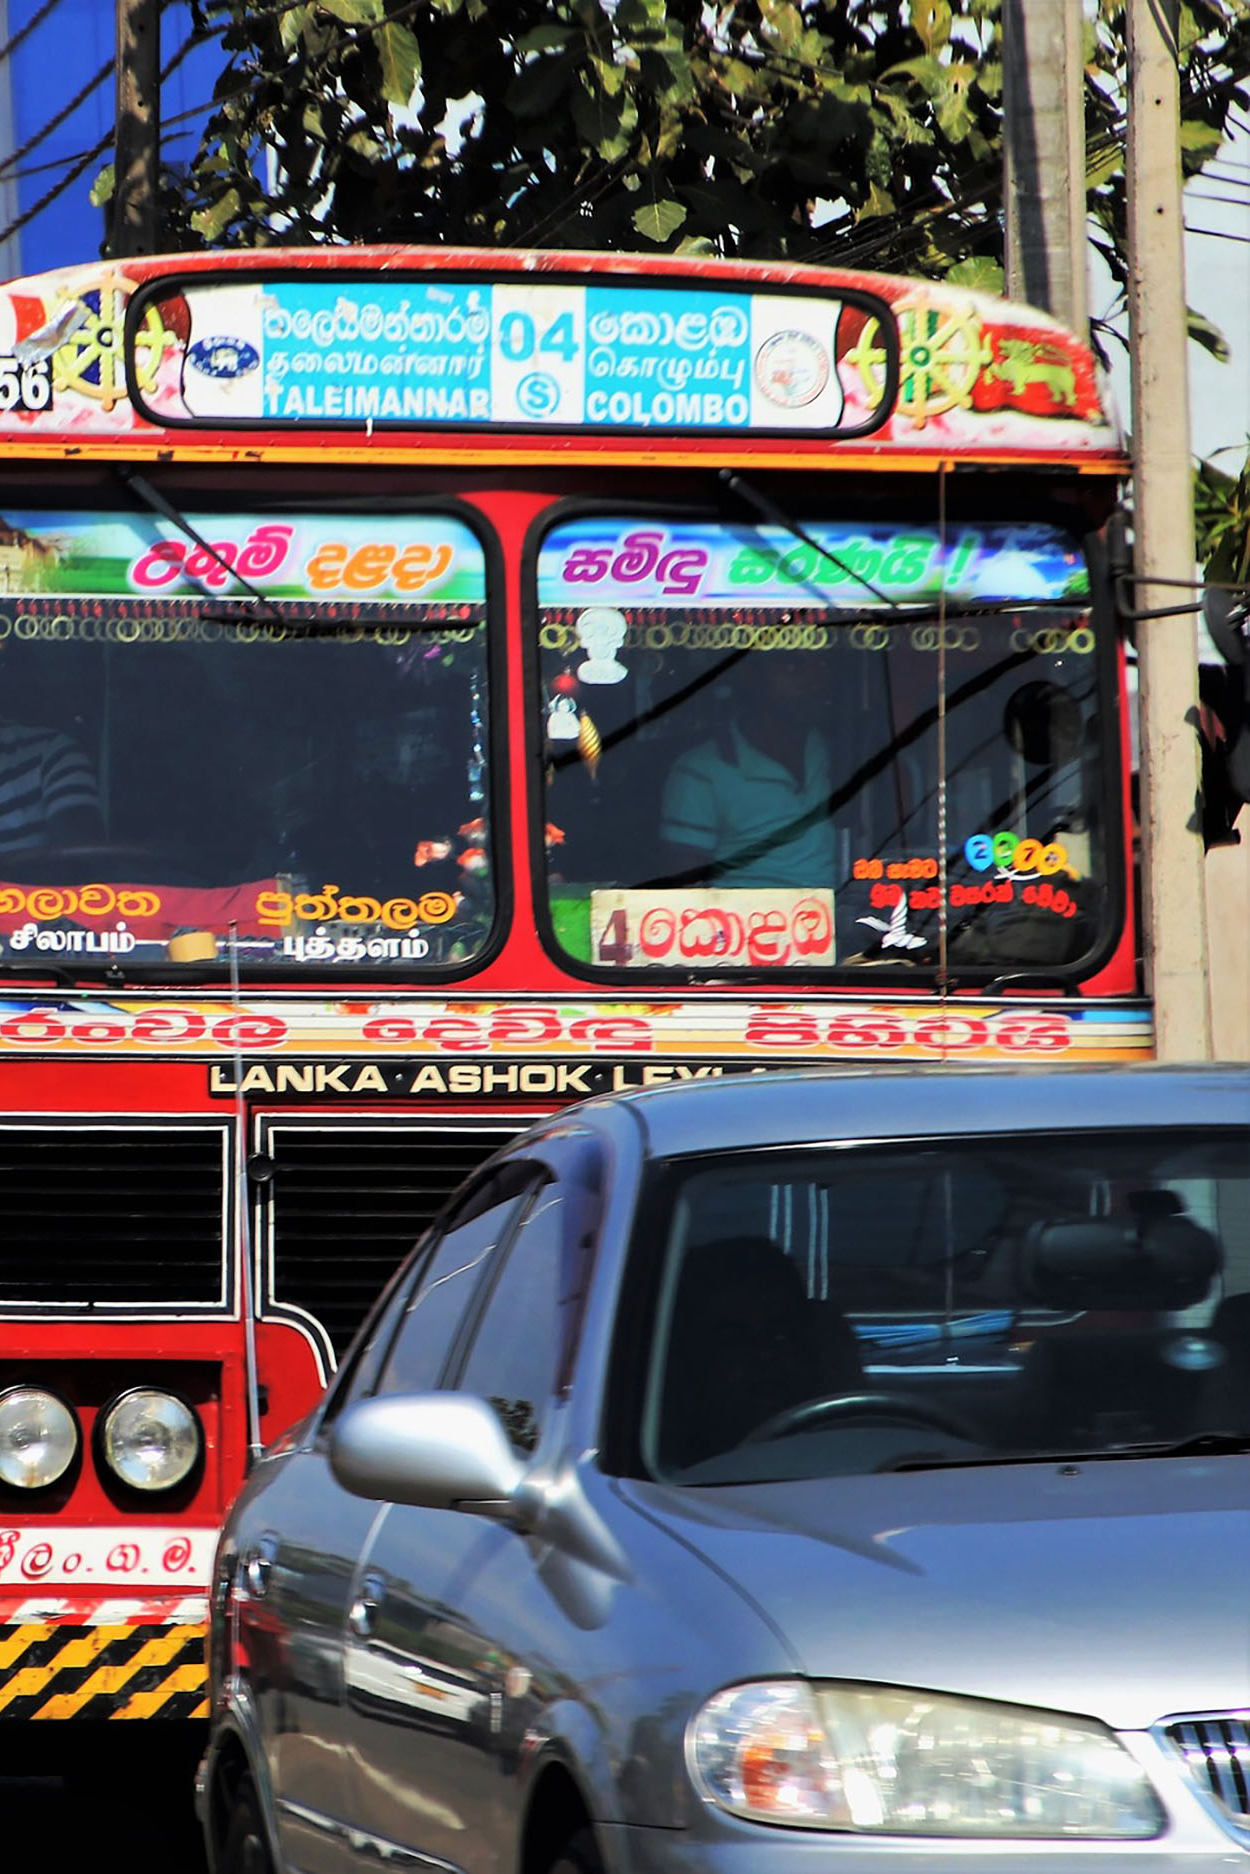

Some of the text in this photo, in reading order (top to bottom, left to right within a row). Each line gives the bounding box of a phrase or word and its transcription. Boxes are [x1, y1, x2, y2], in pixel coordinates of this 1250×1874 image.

[499, 310, 579, 364] 04
[588, 304, 749, 351] කොළඹ
[588, 345, 745, 391] கொழும்பு
[264, 380, 491, 417] TALEIMANNAR
[587, 390, 749, 425] COLOMBO
[306, 542, 453, 592] දළදා
[256, 883, 458, 929] පුත්තලම
[10, 922, 137, 953] சிலாபம்
[283, 927, 430, 962] புத்தளம்
[638, 898, 835, 967] කොළඹ
[210, 1064, 389, 1093] LANKA
[410, 1064, 597, 1093] ASHOK
